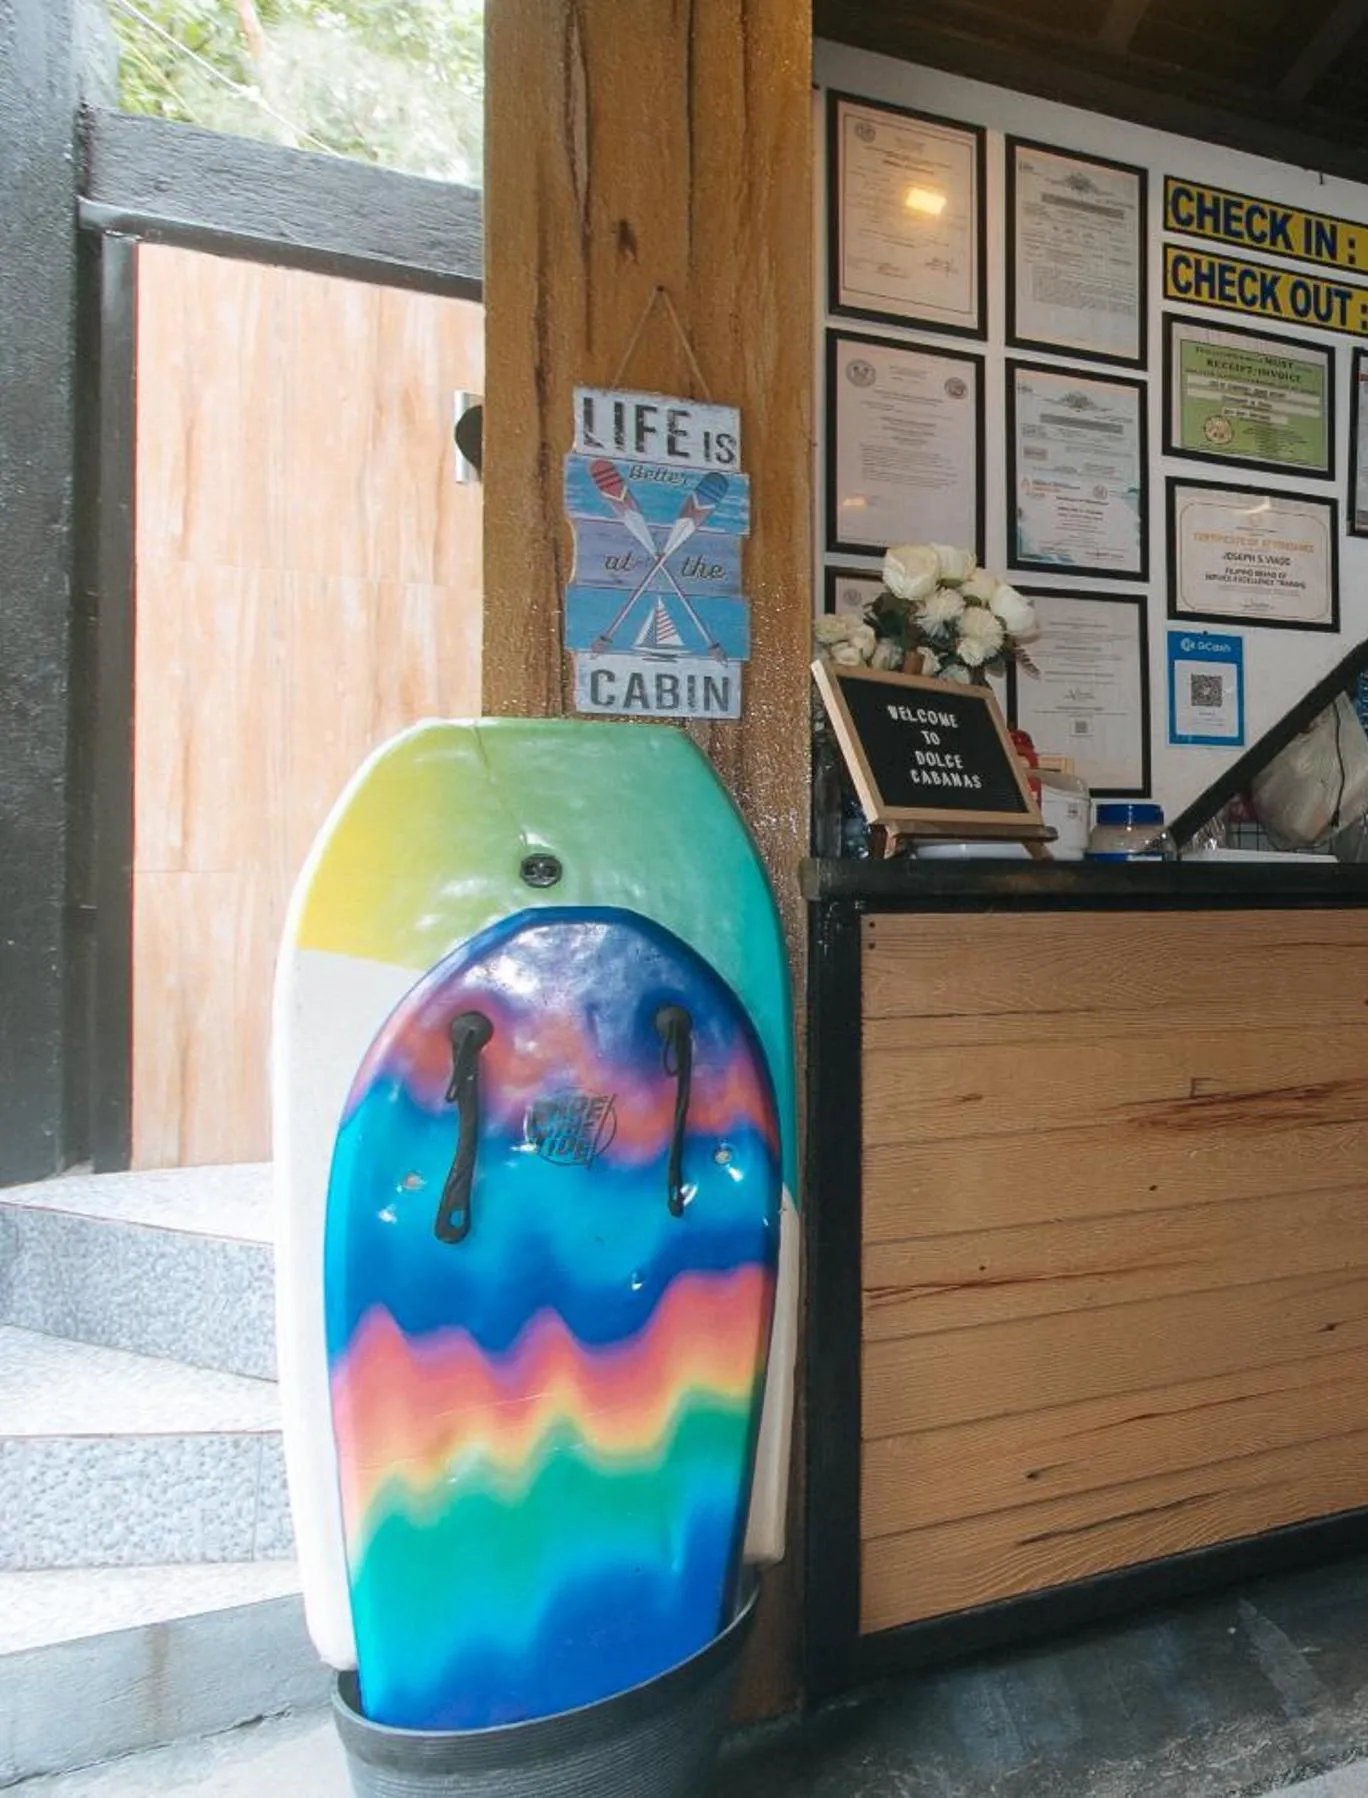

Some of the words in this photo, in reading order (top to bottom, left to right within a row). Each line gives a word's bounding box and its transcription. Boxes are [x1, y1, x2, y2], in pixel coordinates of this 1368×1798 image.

[1171, 186, 1293, 251] CHECK
[1303, 219, 1338, 261] IN
[1172, 254, 1282, 313] CHECK
[1290, 280, 1353, 327] OUT
[582, 397, 691, 458] LIFE
[703, 432, 737, 465] IS
[628, 464, 691, 486] Better
[604, 552, 635, 572] at
[681, 554, 725, 580] the
[589, 668, 730, 713] CABIN
[887, 704, 960, 729] WELCOME
[921, 730, 941, 746] TO
[915, 750, 964, 770] DOLCE
[910, 769, 983, 789] CABANAS
